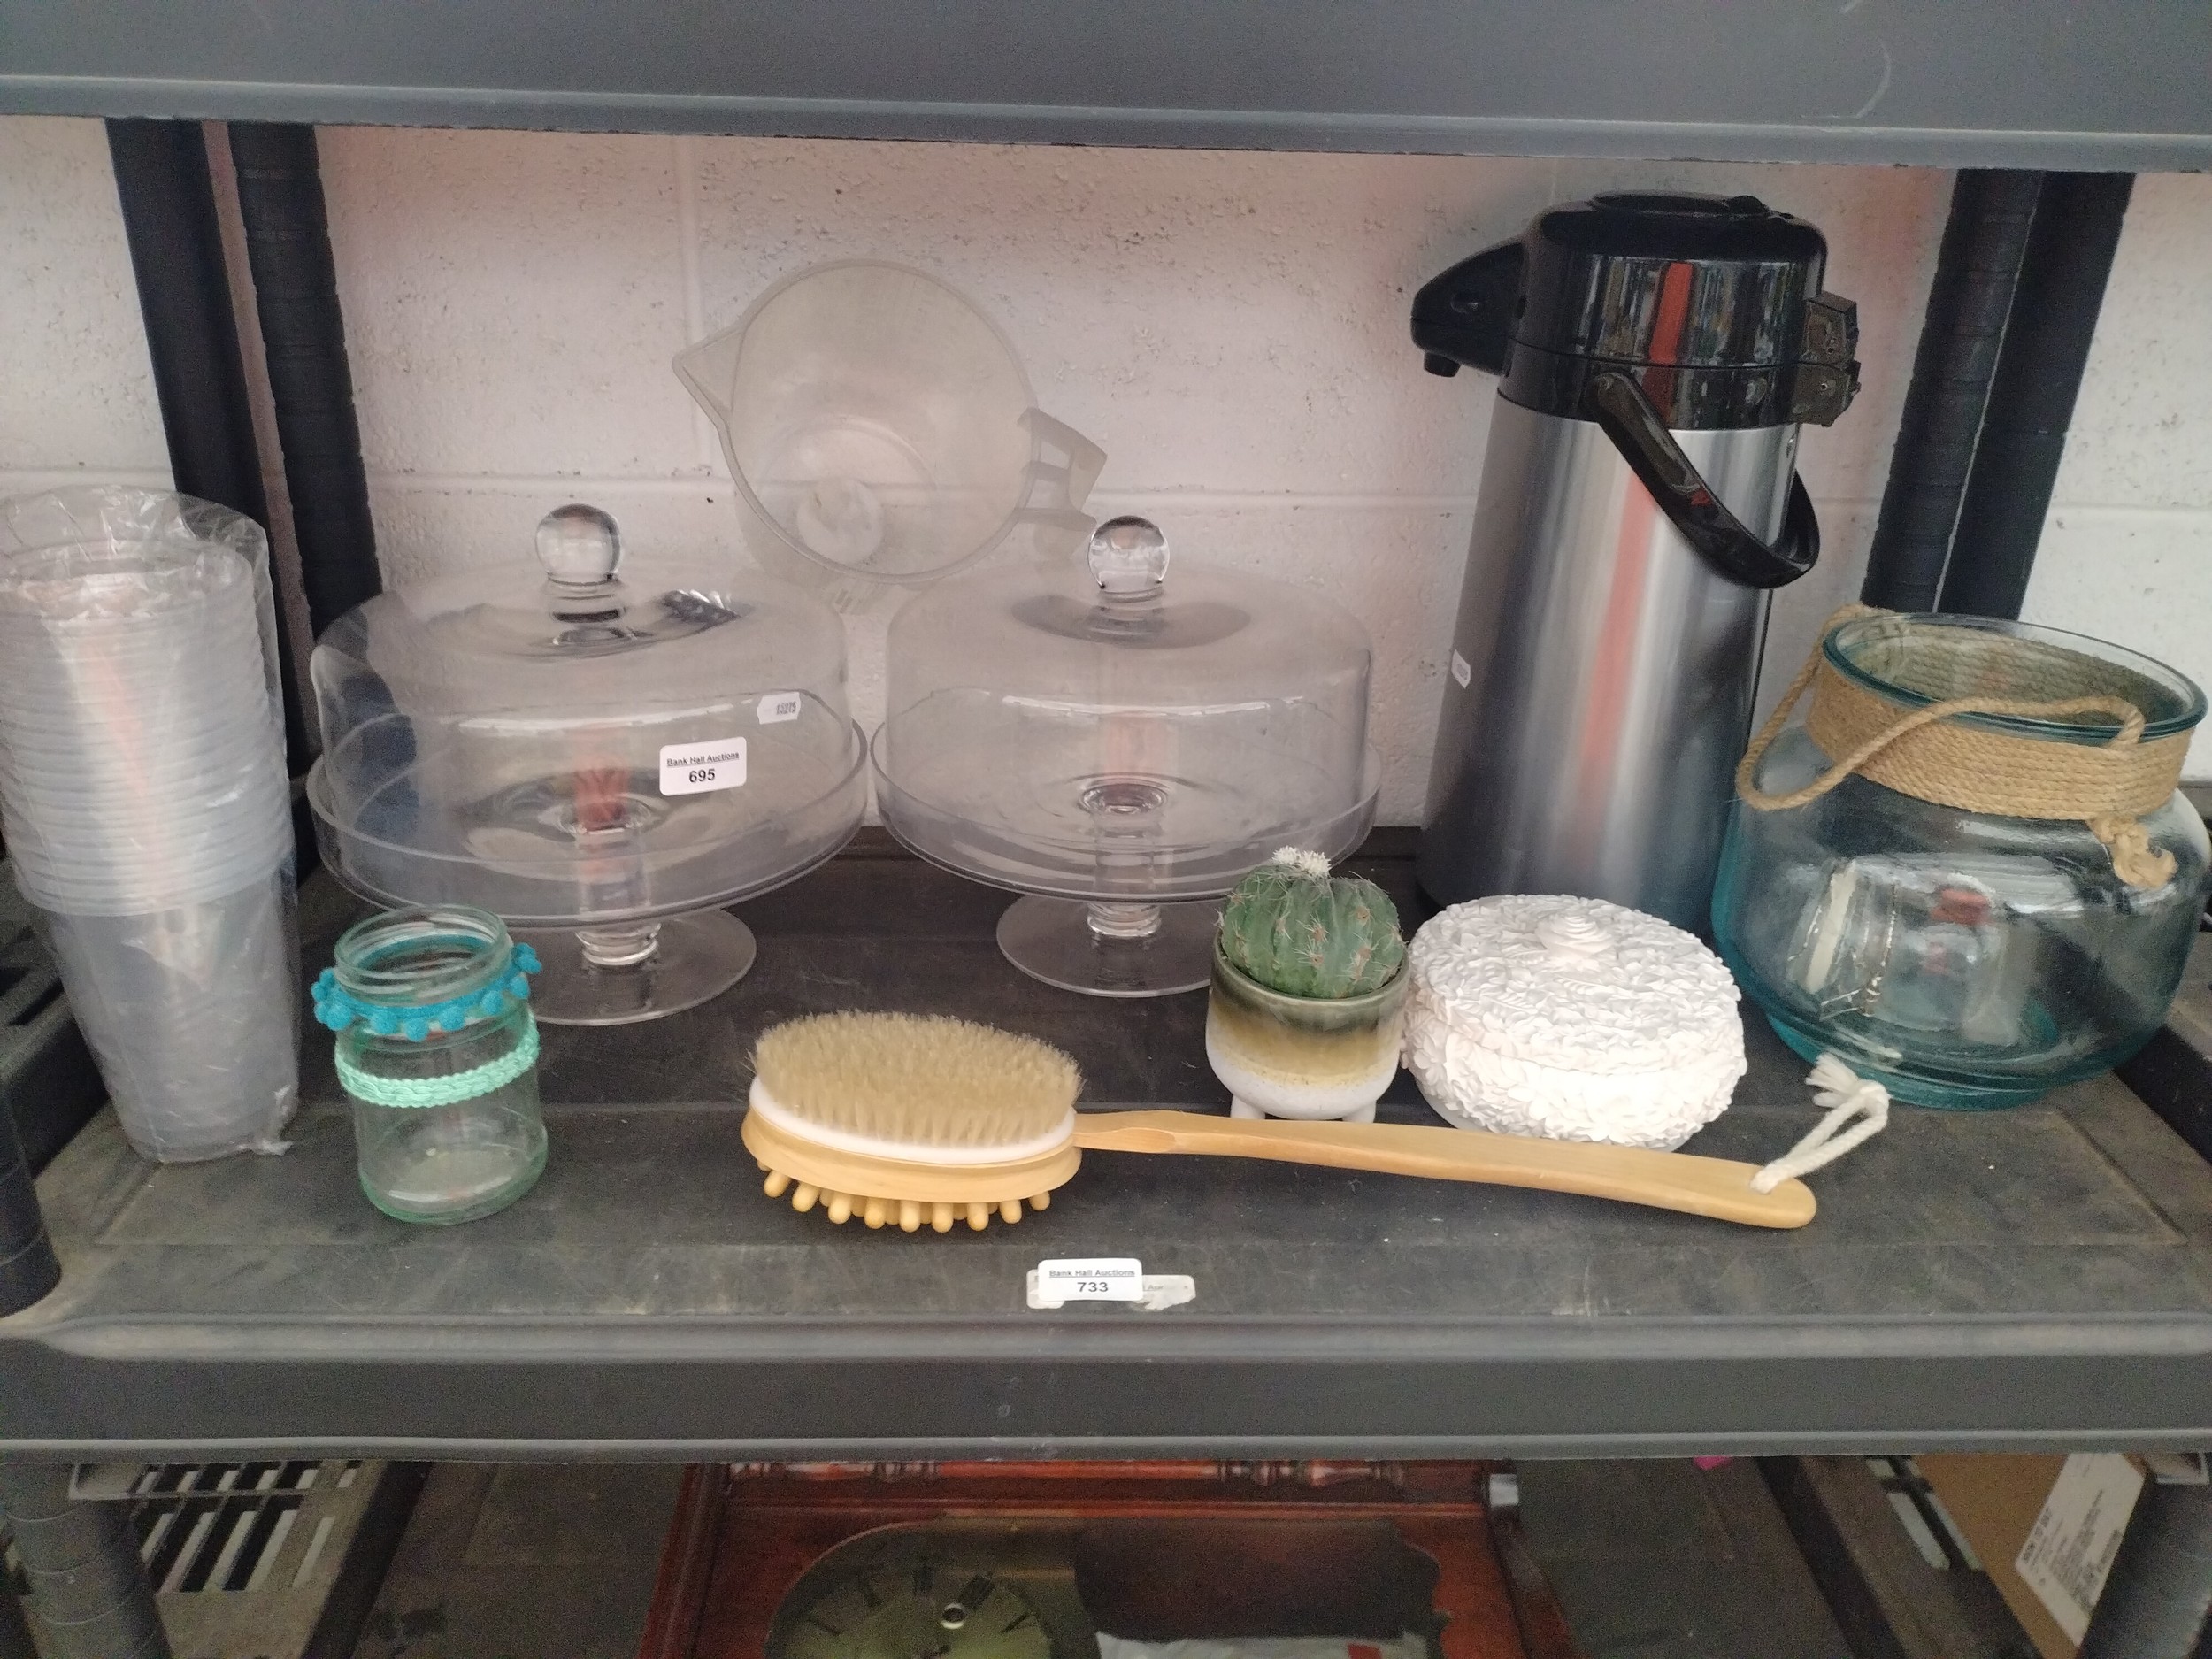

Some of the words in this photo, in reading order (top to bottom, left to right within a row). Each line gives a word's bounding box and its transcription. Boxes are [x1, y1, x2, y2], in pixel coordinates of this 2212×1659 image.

[666, 757, 688, 767] Bank
[689, 756, 706, 764] Hall
[706, 752, 740, 763] Auctions
[688, 768, 716, 783] 695
[1077, 1282, 1109, 1293] 733
